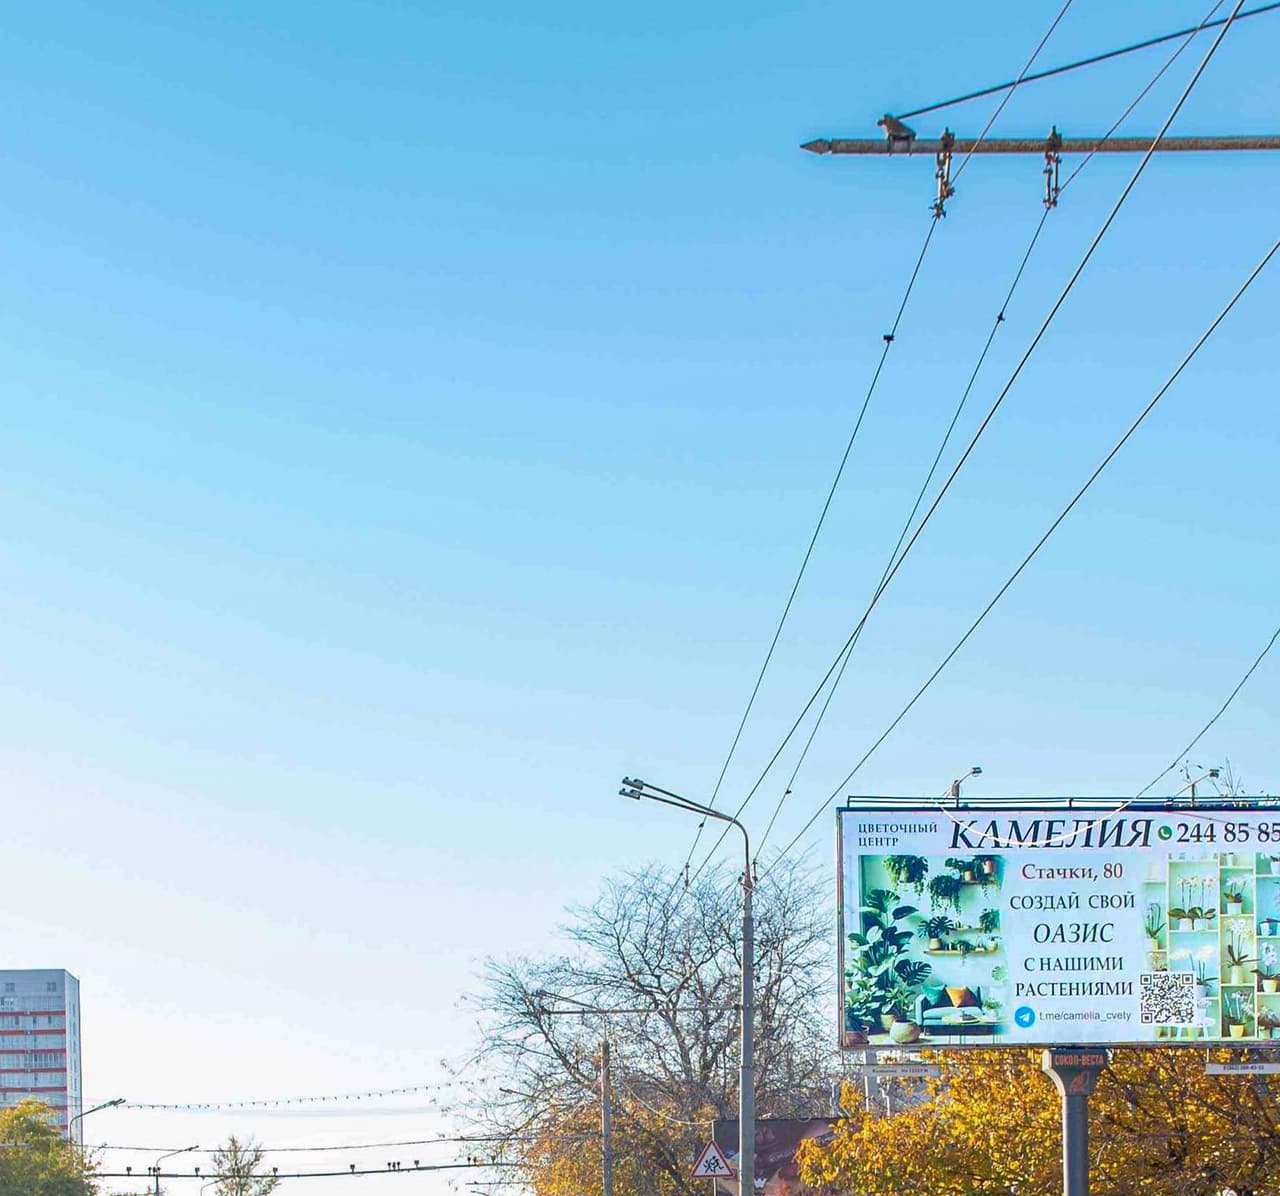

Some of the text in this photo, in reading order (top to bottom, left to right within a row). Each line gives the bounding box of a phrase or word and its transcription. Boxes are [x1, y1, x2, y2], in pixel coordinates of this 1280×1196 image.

[858, 822, 938, 834] ЦВЕТОЧНЫЙ
[948, 818, 1155, 849] КАМЕЛИЯ
[1176, 821, 1217, 843] 244
[1223, 821, 1250, 843] 85
[858, 837, 899, 848] ЦЕНТР
[1021, 862, 1123, 882] Стачки, 80
[1009, 890, 1136, 912] СОЗДАЙ СВОЙ
[1033, 922, 1115, 944] ОАЗИС
[1023, 956, 1124, 972] С НАШИМИ
[1015, 981, 1133, 997] РАСТЕНИЯМИ
[1038, 1010, 1132, 1023] t.me/camelia_cvety
